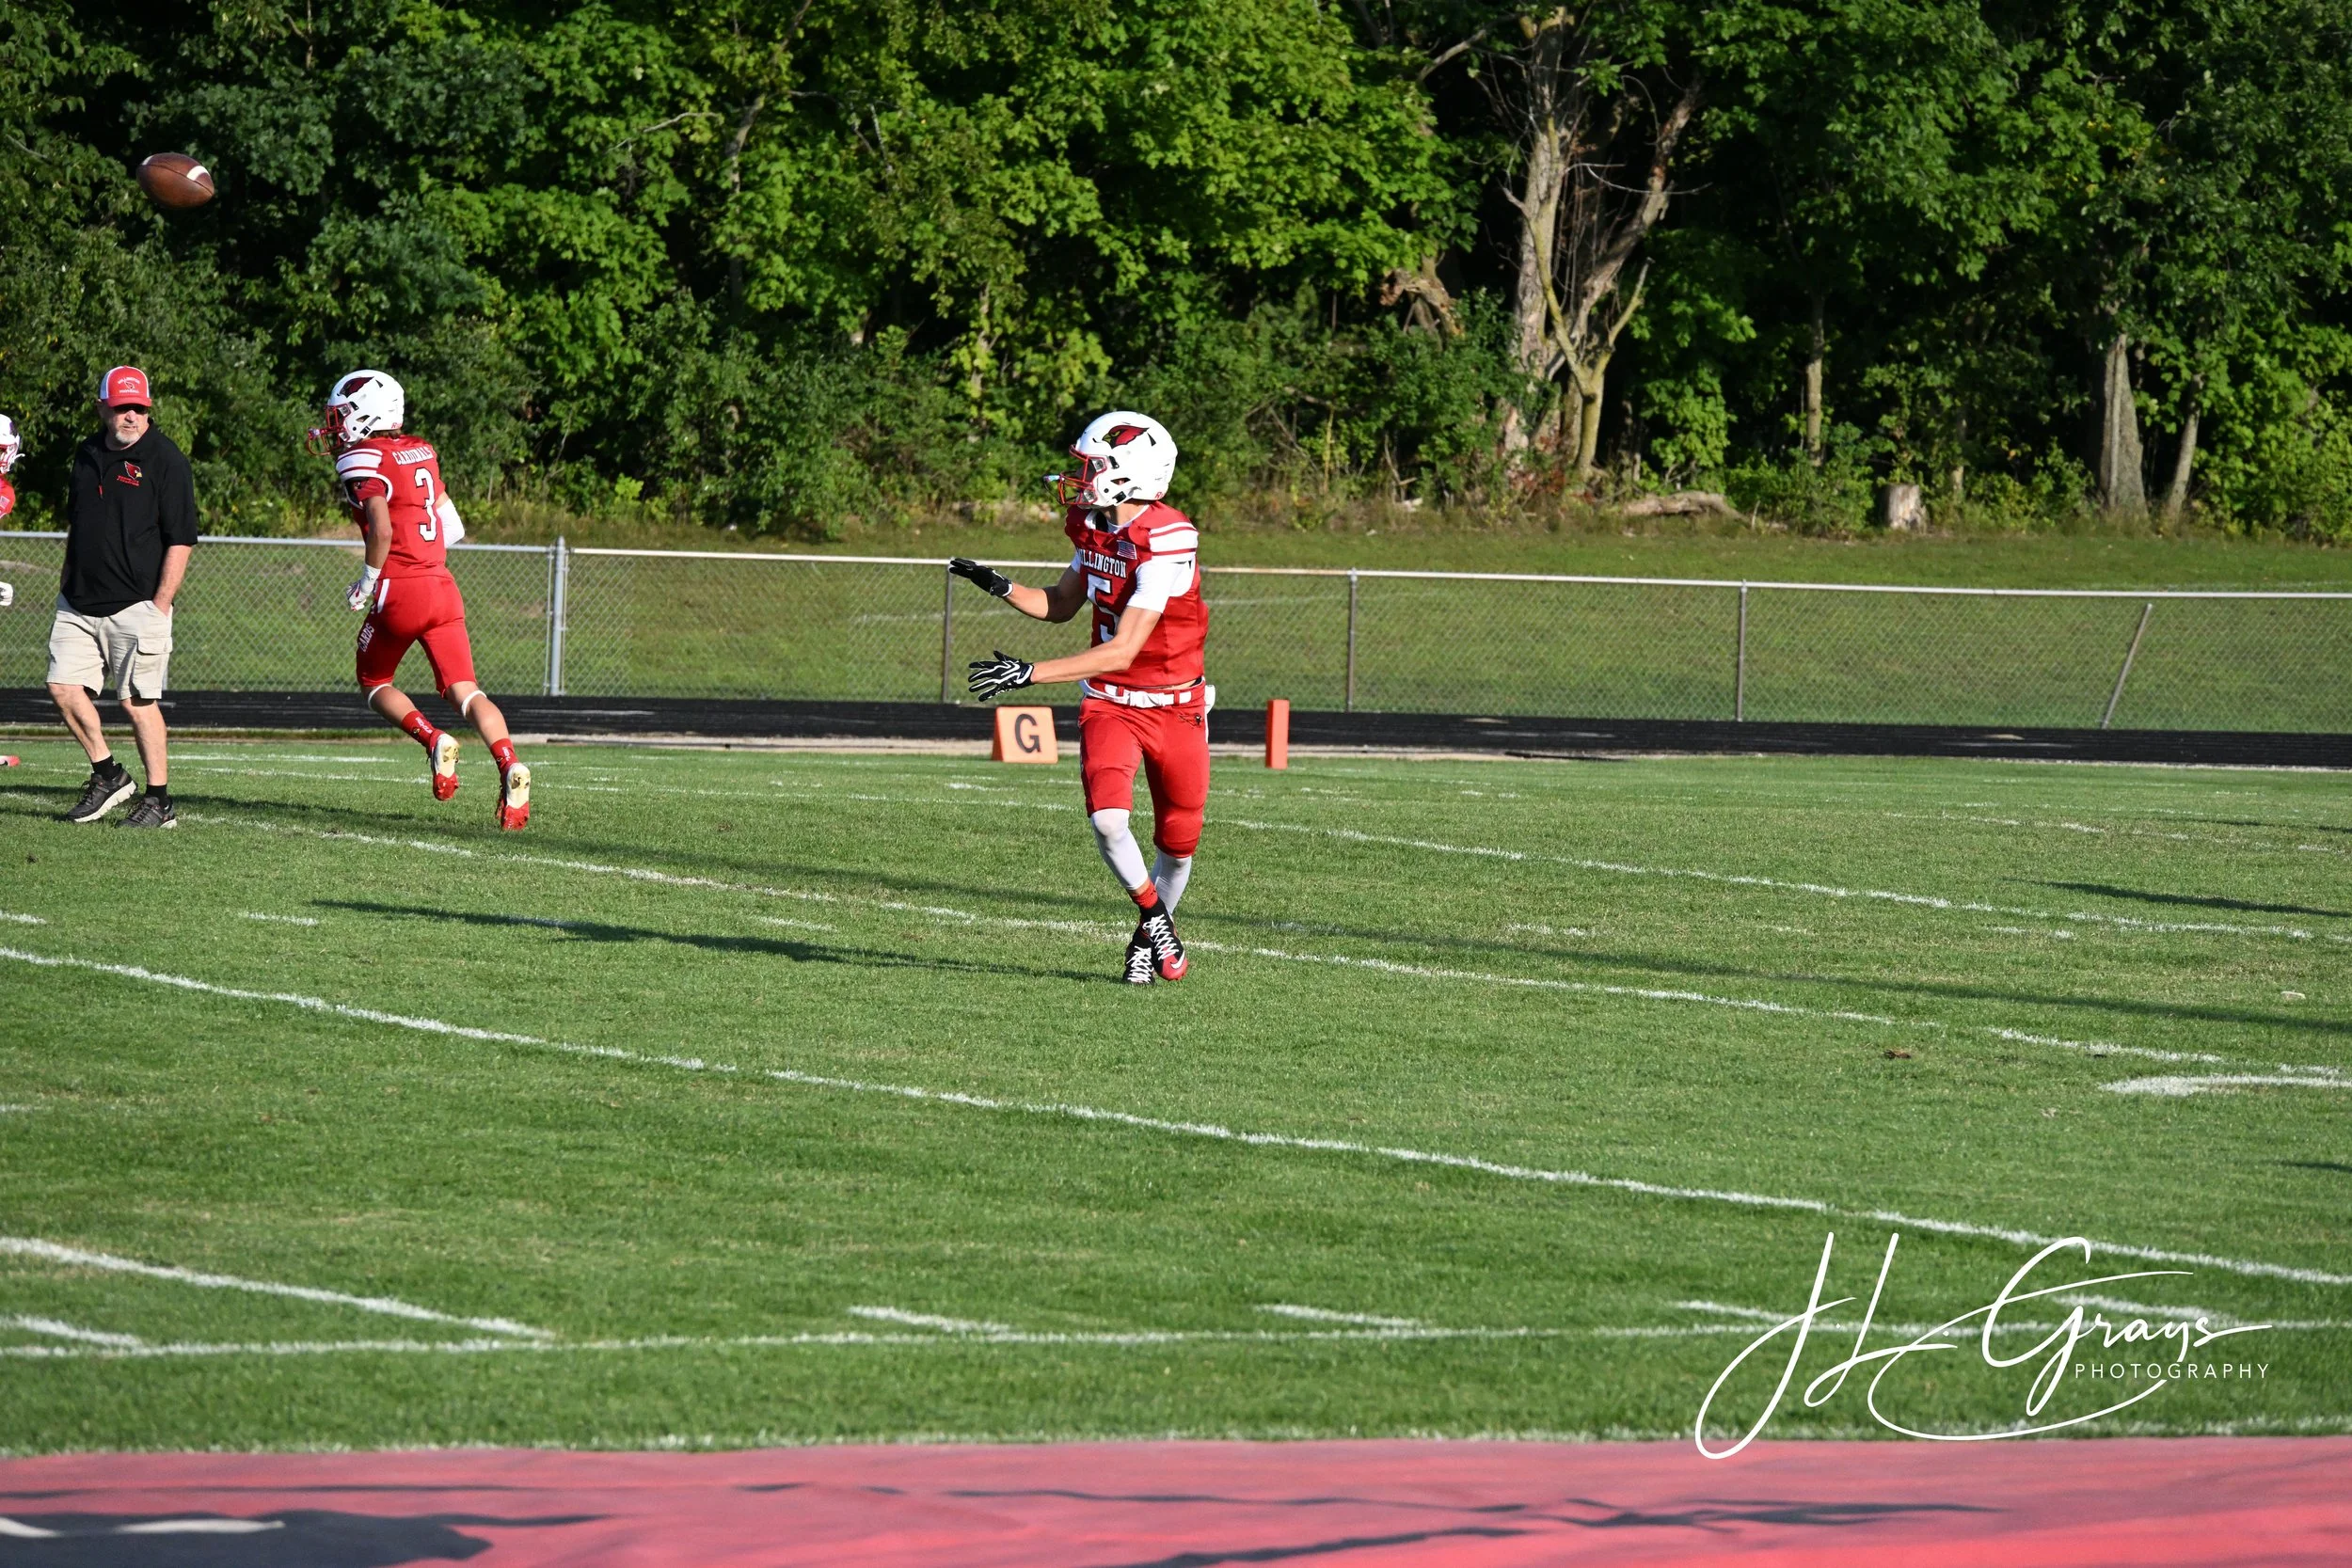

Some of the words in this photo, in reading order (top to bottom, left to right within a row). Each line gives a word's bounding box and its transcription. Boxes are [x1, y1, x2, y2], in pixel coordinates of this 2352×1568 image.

[414, 467, 437, 542] 3
[1087, 573, 1121, 644] 5
[1014, 713, 1041, 753] G
